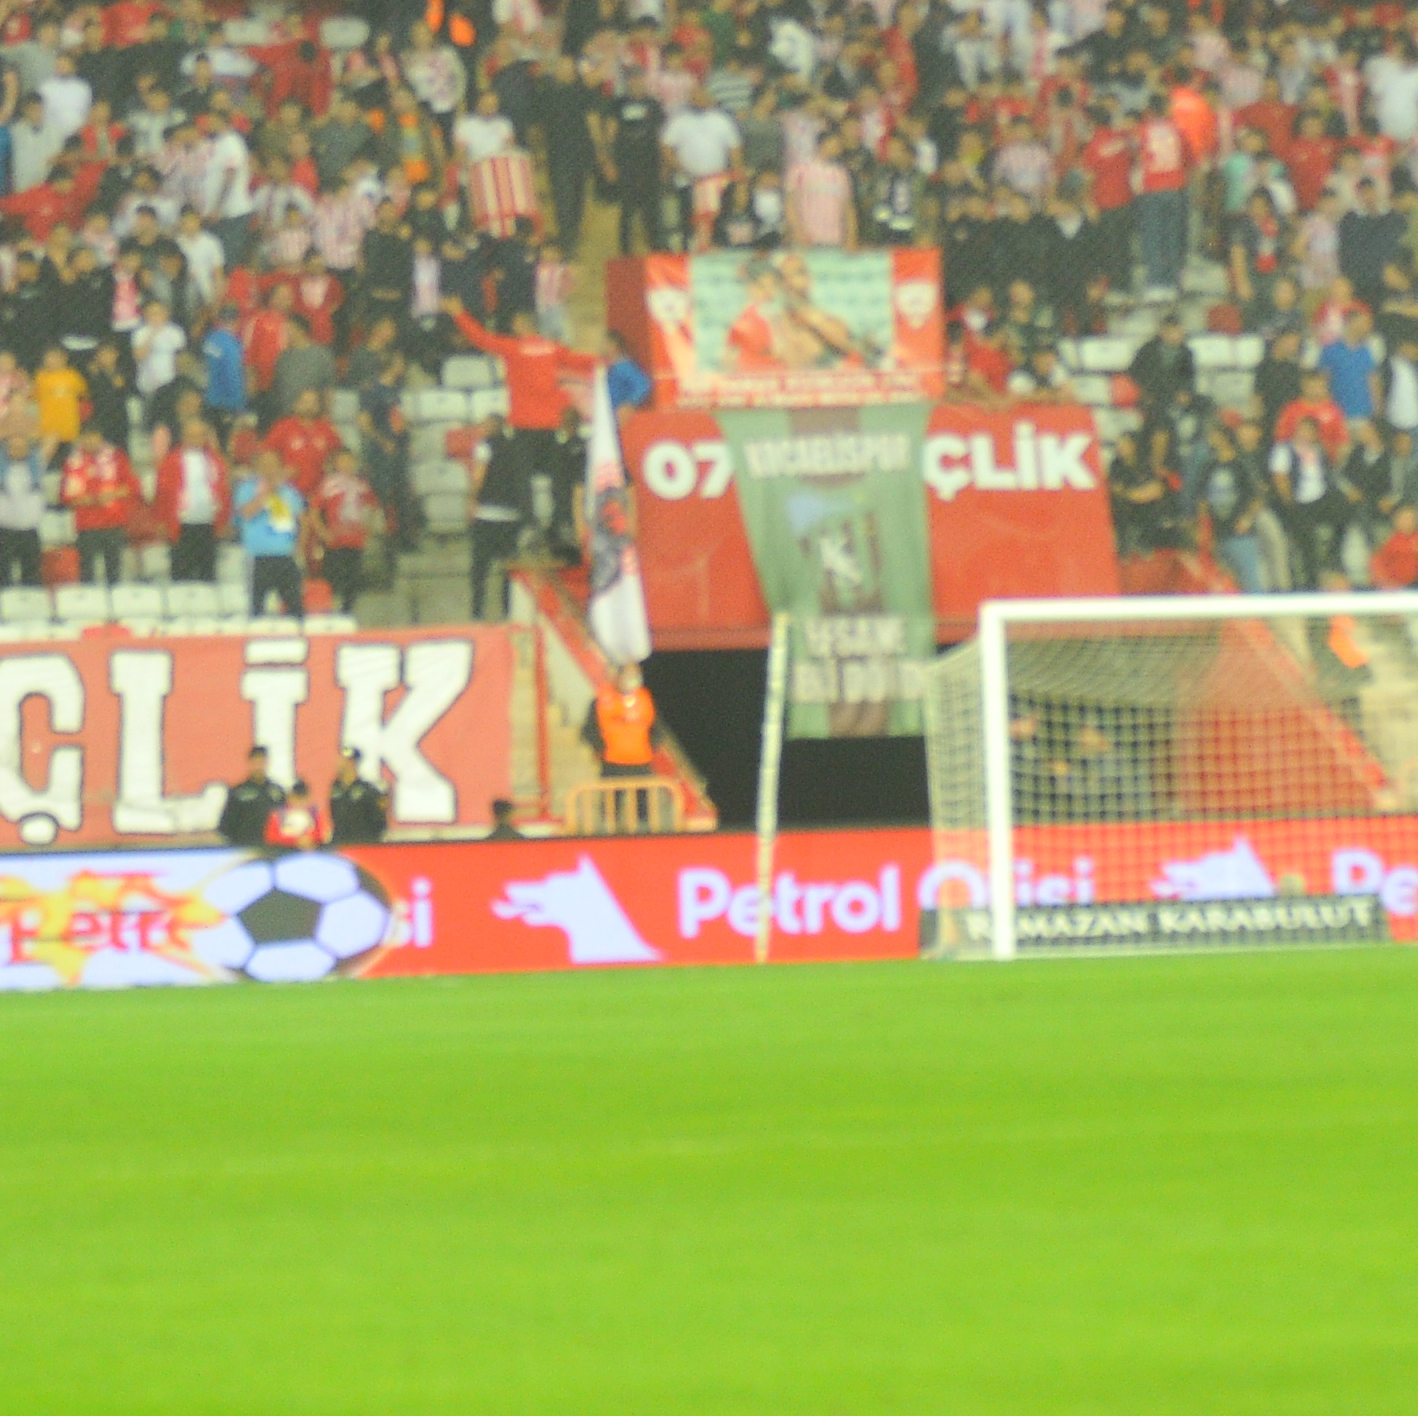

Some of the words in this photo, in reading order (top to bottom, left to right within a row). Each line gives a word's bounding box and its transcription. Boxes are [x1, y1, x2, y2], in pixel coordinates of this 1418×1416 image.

[922, 420, 1096, 502] ÇLİK
[678, 862, 901, 939] Petrol
[965, 906, 1148, 943] RMAZAN
